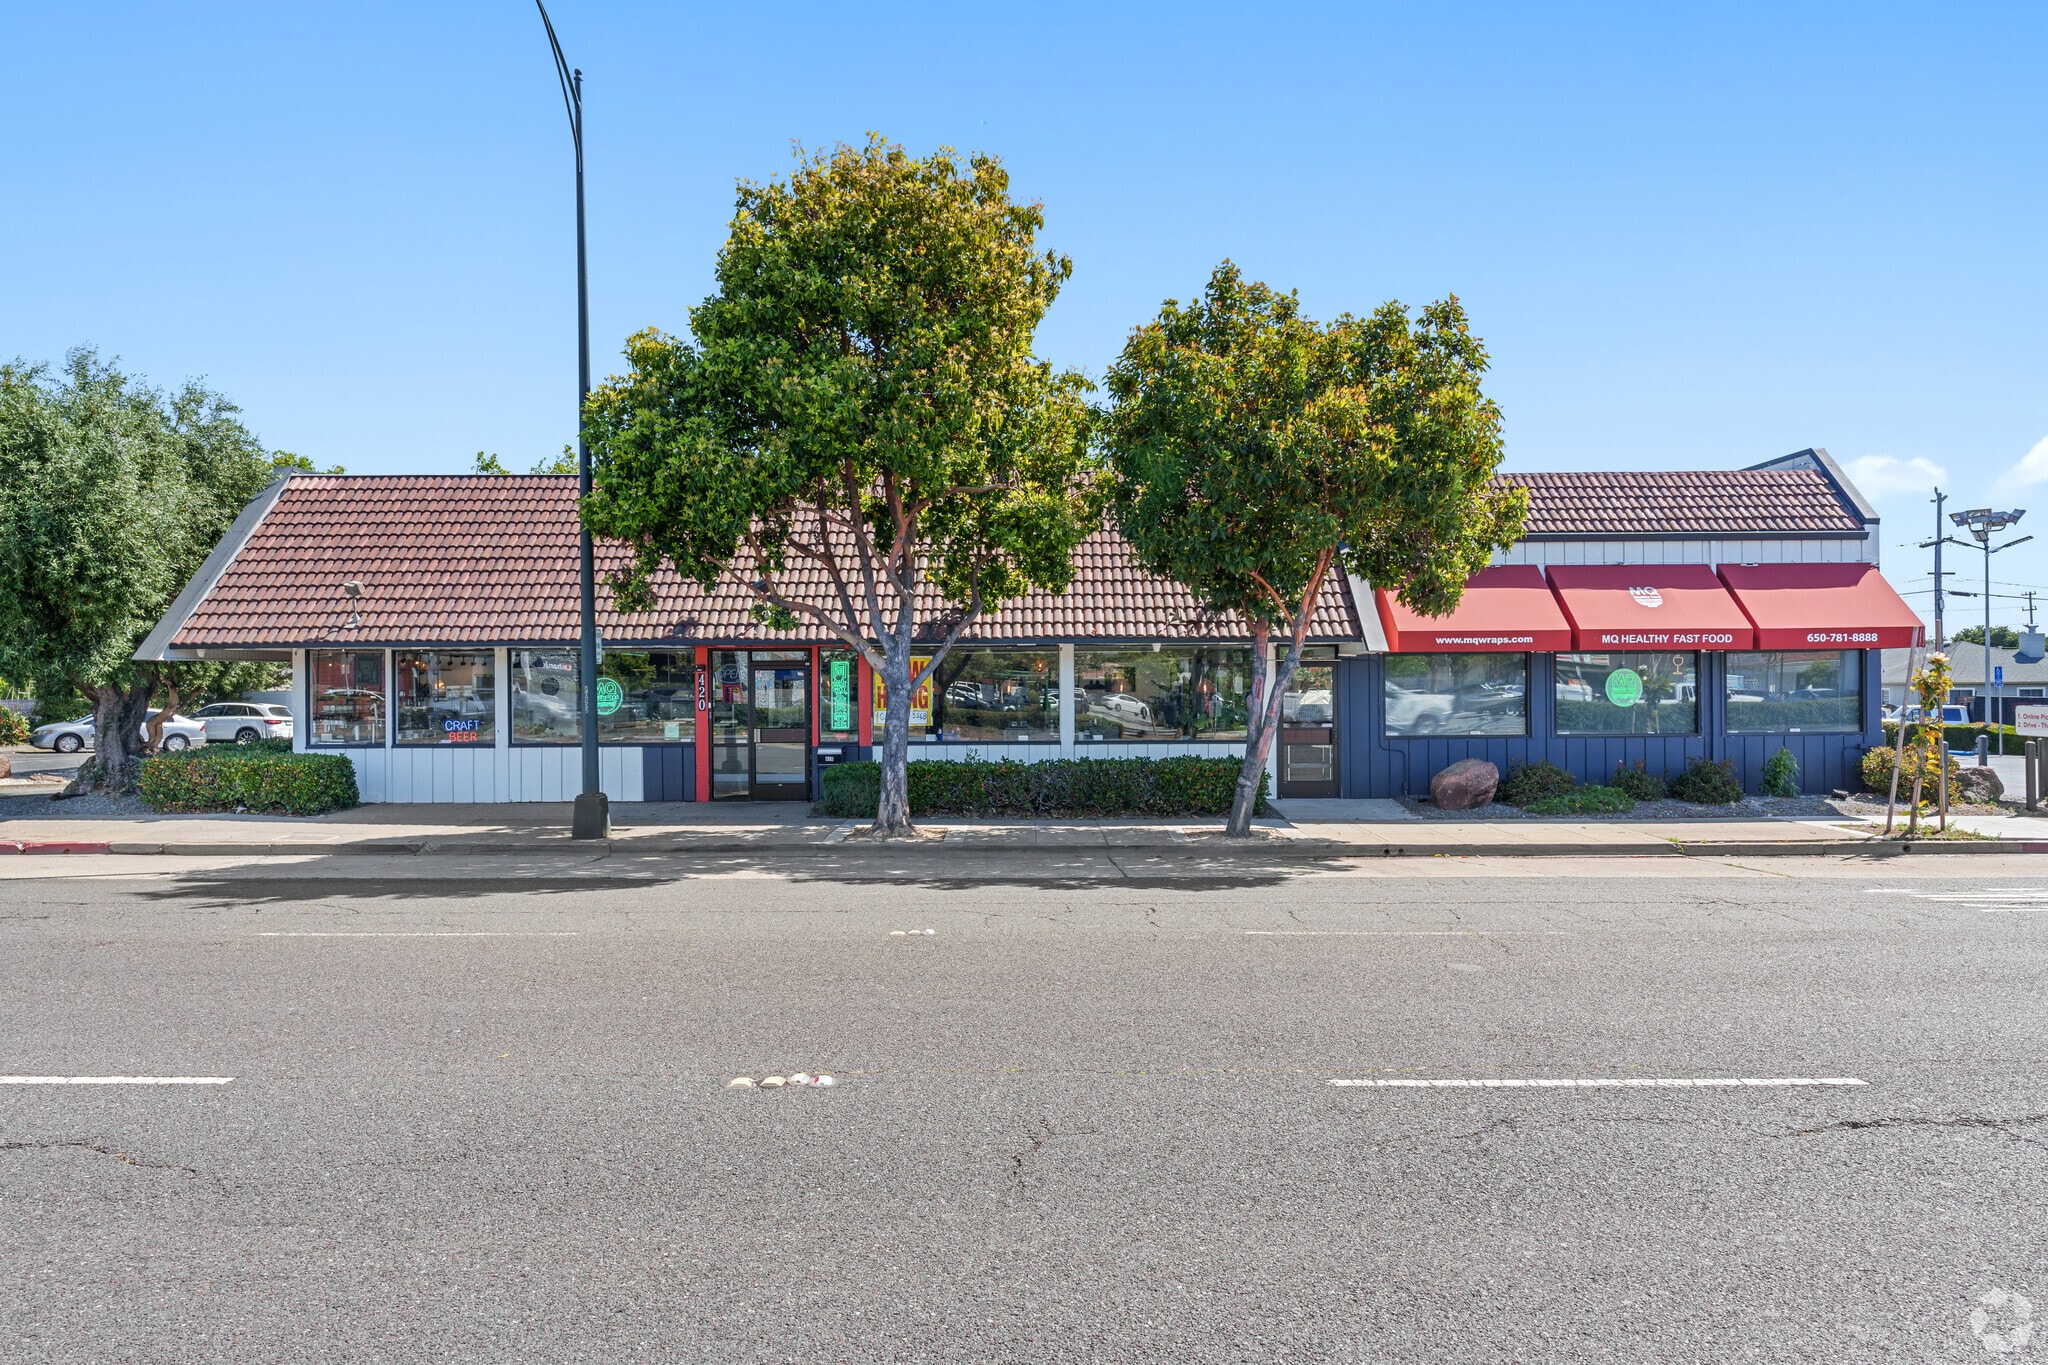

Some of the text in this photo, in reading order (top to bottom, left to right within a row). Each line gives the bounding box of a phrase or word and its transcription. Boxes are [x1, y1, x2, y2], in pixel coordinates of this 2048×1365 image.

[1628, 586, 1660, 596] MQ
[1435, 635, 1533, 646] www.mqwraps.com
[1601, 634, 1733, 644] MQ HEALTHY FAST FOOD
[1806, 633, 1878, 643] 650-781-8888
[1612, 673, 1636, 686] MQ
[698, 673, 706, 711] 420
[444, 720, 479, 731] CRAFT
[449, 731, 477, 742] BEER
